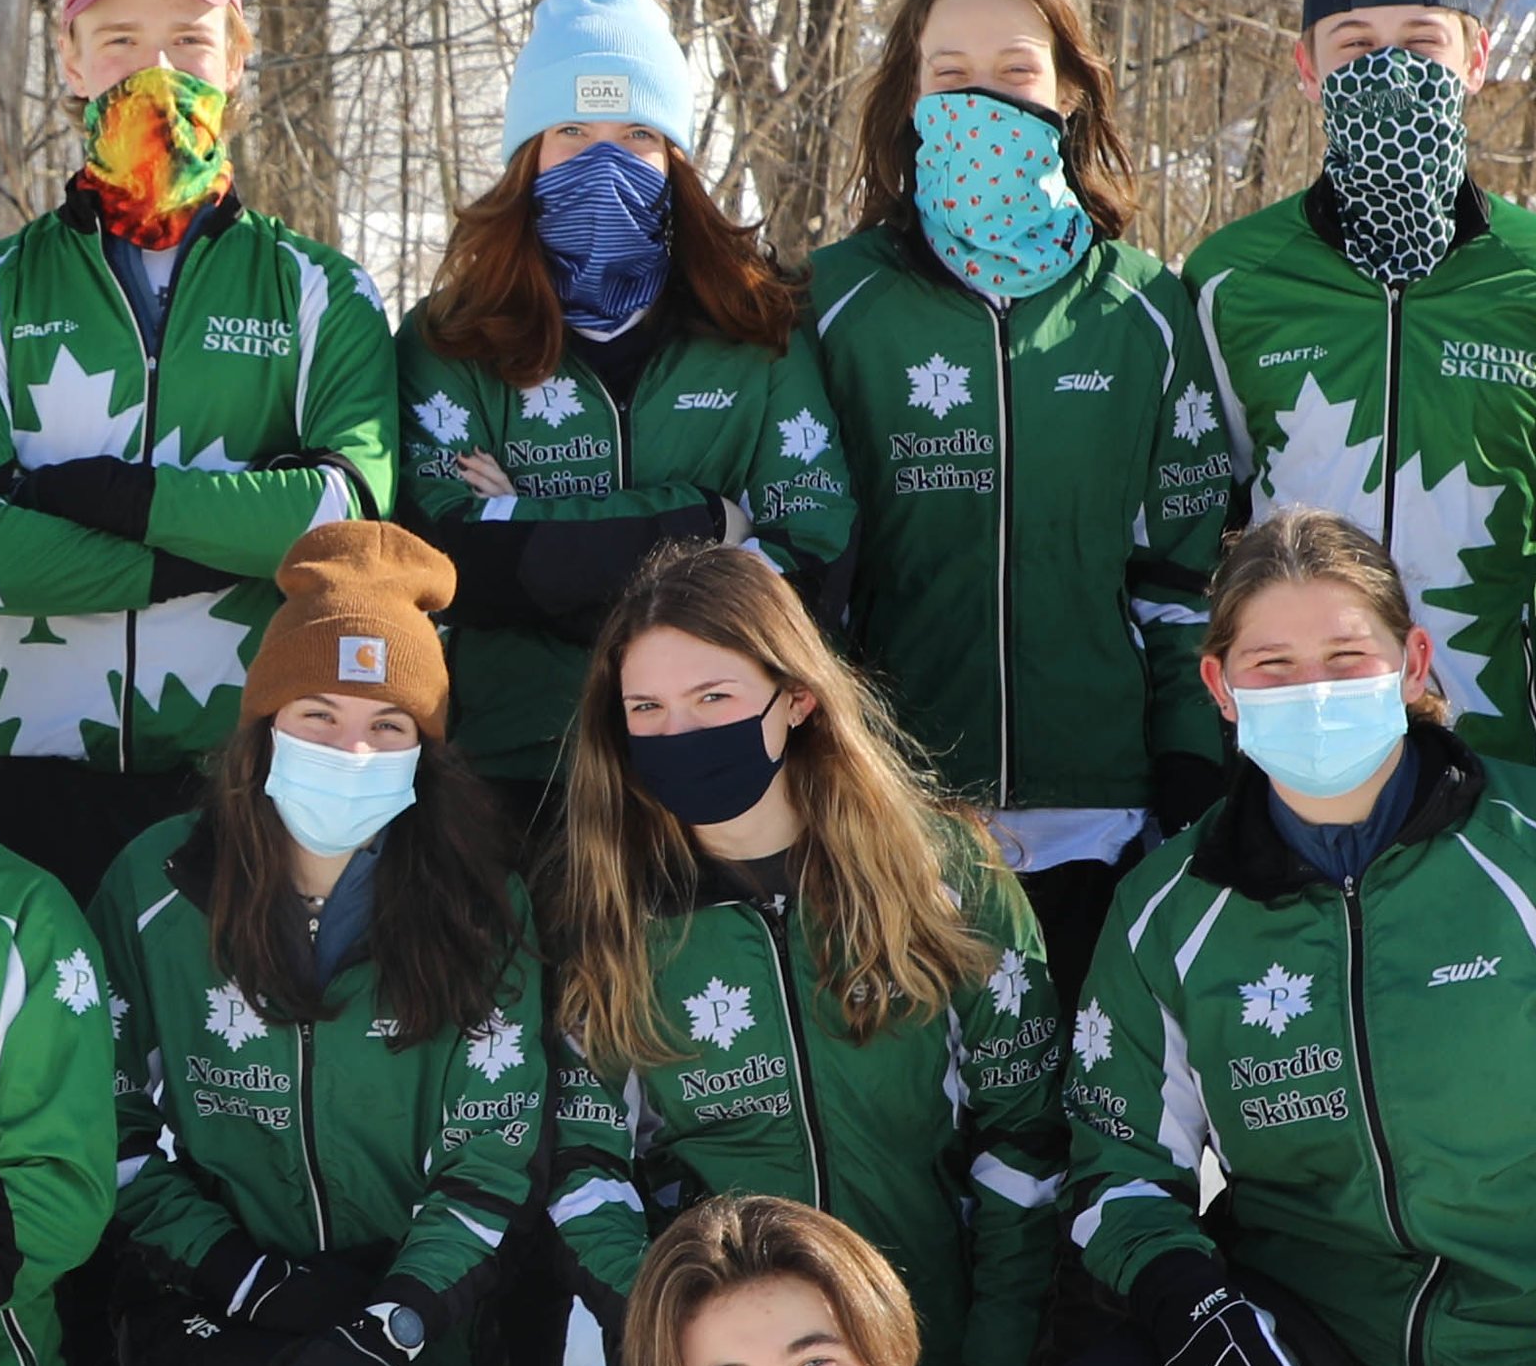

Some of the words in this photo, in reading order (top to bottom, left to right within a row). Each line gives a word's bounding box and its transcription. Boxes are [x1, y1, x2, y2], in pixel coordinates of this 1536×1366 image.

[581, 86, 624, 98] COAL
[13, 319, 63, 340] CRAFT
[1259, 346, 1312, 368] CRAFT
[932, 373, 950, 397] P
[1054, 370, 1114, 392] swix
[544, 386, 558, 407] P
[675, 388, 736, 410] swix
[436, 406, 453, 428] P
[506, 434, 611, 468] Nordic
[801, 426, 817, 449] P
[890, 428, 994, 461] Nordic
[895, 464, 994, 495] Skiing
[1159, 453, 1231, 490] Nordi
[515, 471, 612, 501] Skiing
[73, 969, 91, 995] P
[1428, 955, 1501, 987] swix
[1269, 987, 1289, 1012] P
[228, 1002, 246, 1026] P
[714, 1001, 731, 1029] P
[488, 1036, 504, 1059] P
[187, 1055, 292, 1093] Nordic
[679, 1055, 788, 1100] Nordic
[1229, 1044, 1344, 1089] Nordic
[193, 1091, 292, 1129] Skiing
[695, 1088, 791, 1125] Skiing
[1240, 1086, 1348, 1129] Skiing
